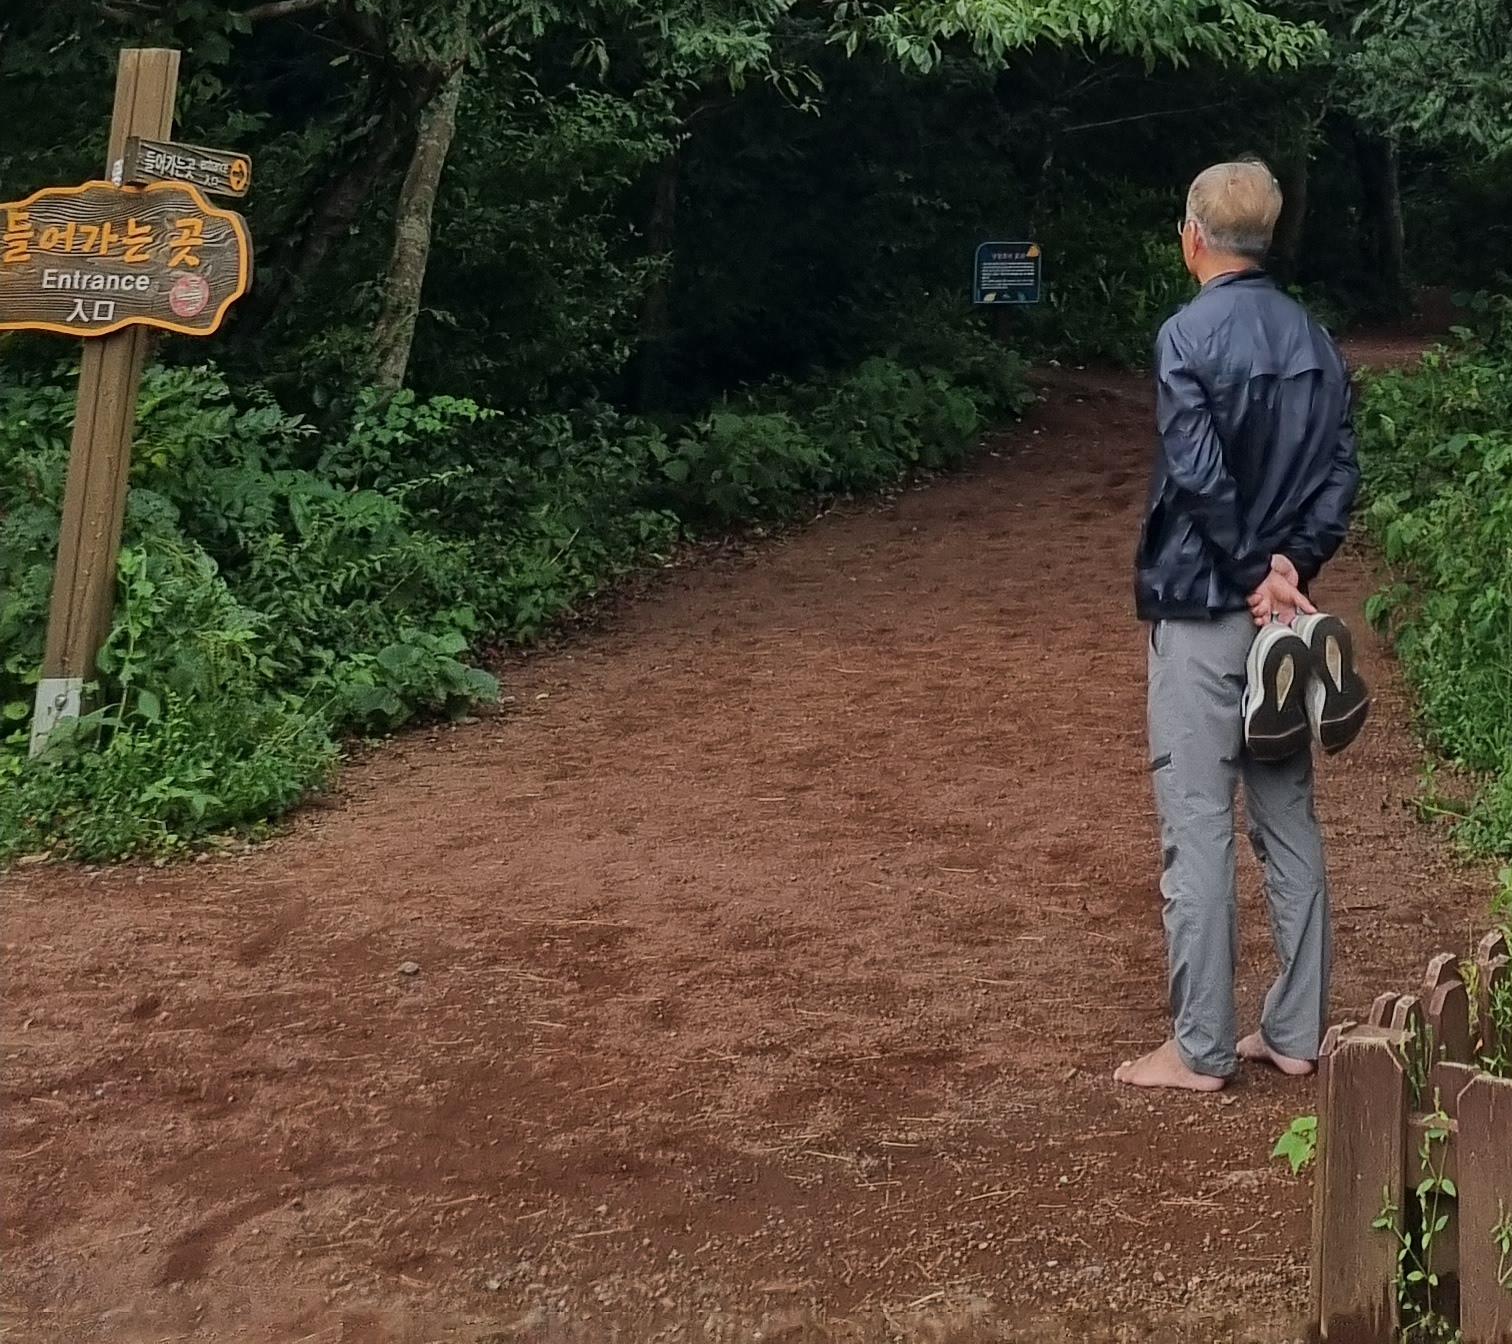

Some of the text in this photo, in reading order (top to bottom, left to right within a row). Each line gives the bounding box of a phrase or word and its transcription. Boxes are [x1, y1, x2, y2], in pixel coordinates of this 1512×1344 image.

[2, 209, 205, 268] 들어가는 곳
[41, 268, 151, 291] Entrance
